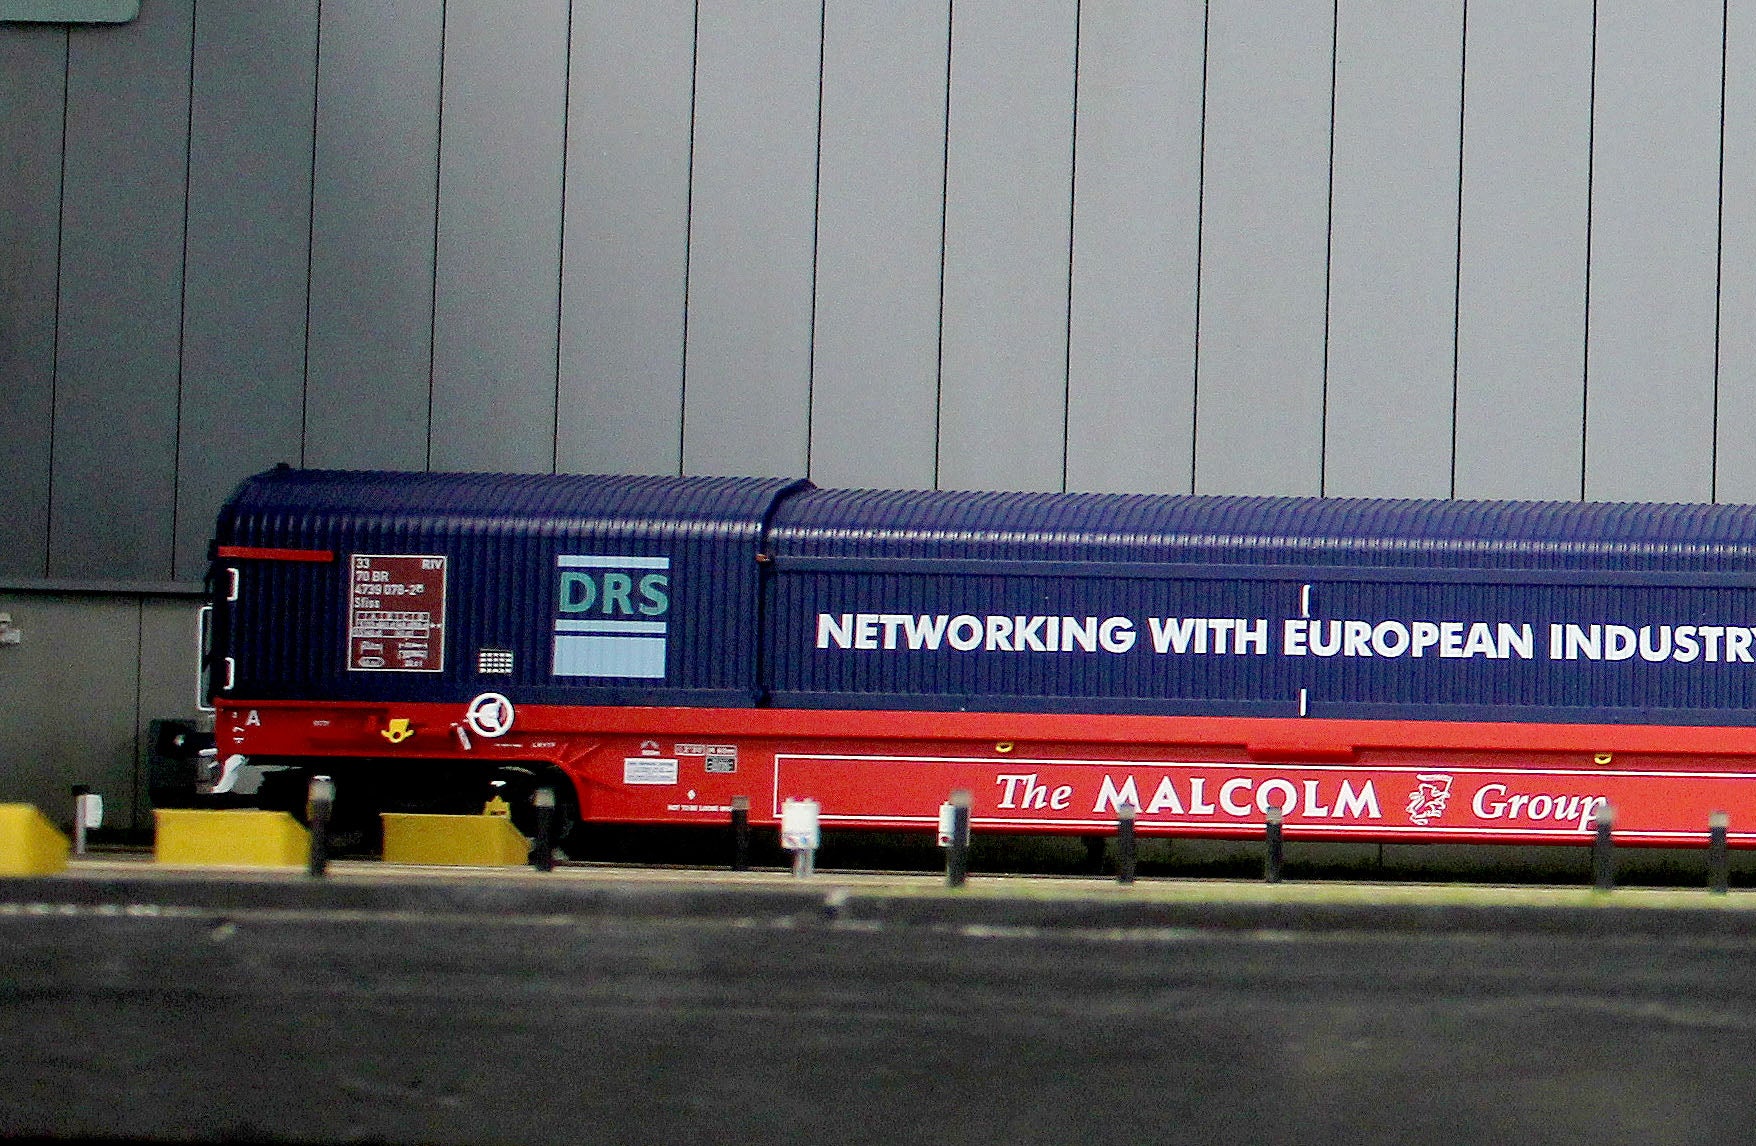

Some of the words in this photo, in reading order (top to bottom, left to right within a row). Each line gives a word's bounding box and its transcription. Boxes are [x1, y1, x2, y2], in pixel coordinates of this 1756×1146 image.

[422, 559, 443, 570] RIV
[559, 571, 669, 616] DRS
[817, 613, 1137, 655] NETWORKING
[1149, 618, 1268, 656] WITH
[1285, 619, 1534, 660] EUROPEAN
[246, 709, 261, 727] A
[996, 773, 1073, 811] The
[1092, 774, 1383, 819] MALCOLM
[1472, 783, 1609, 831] Group
